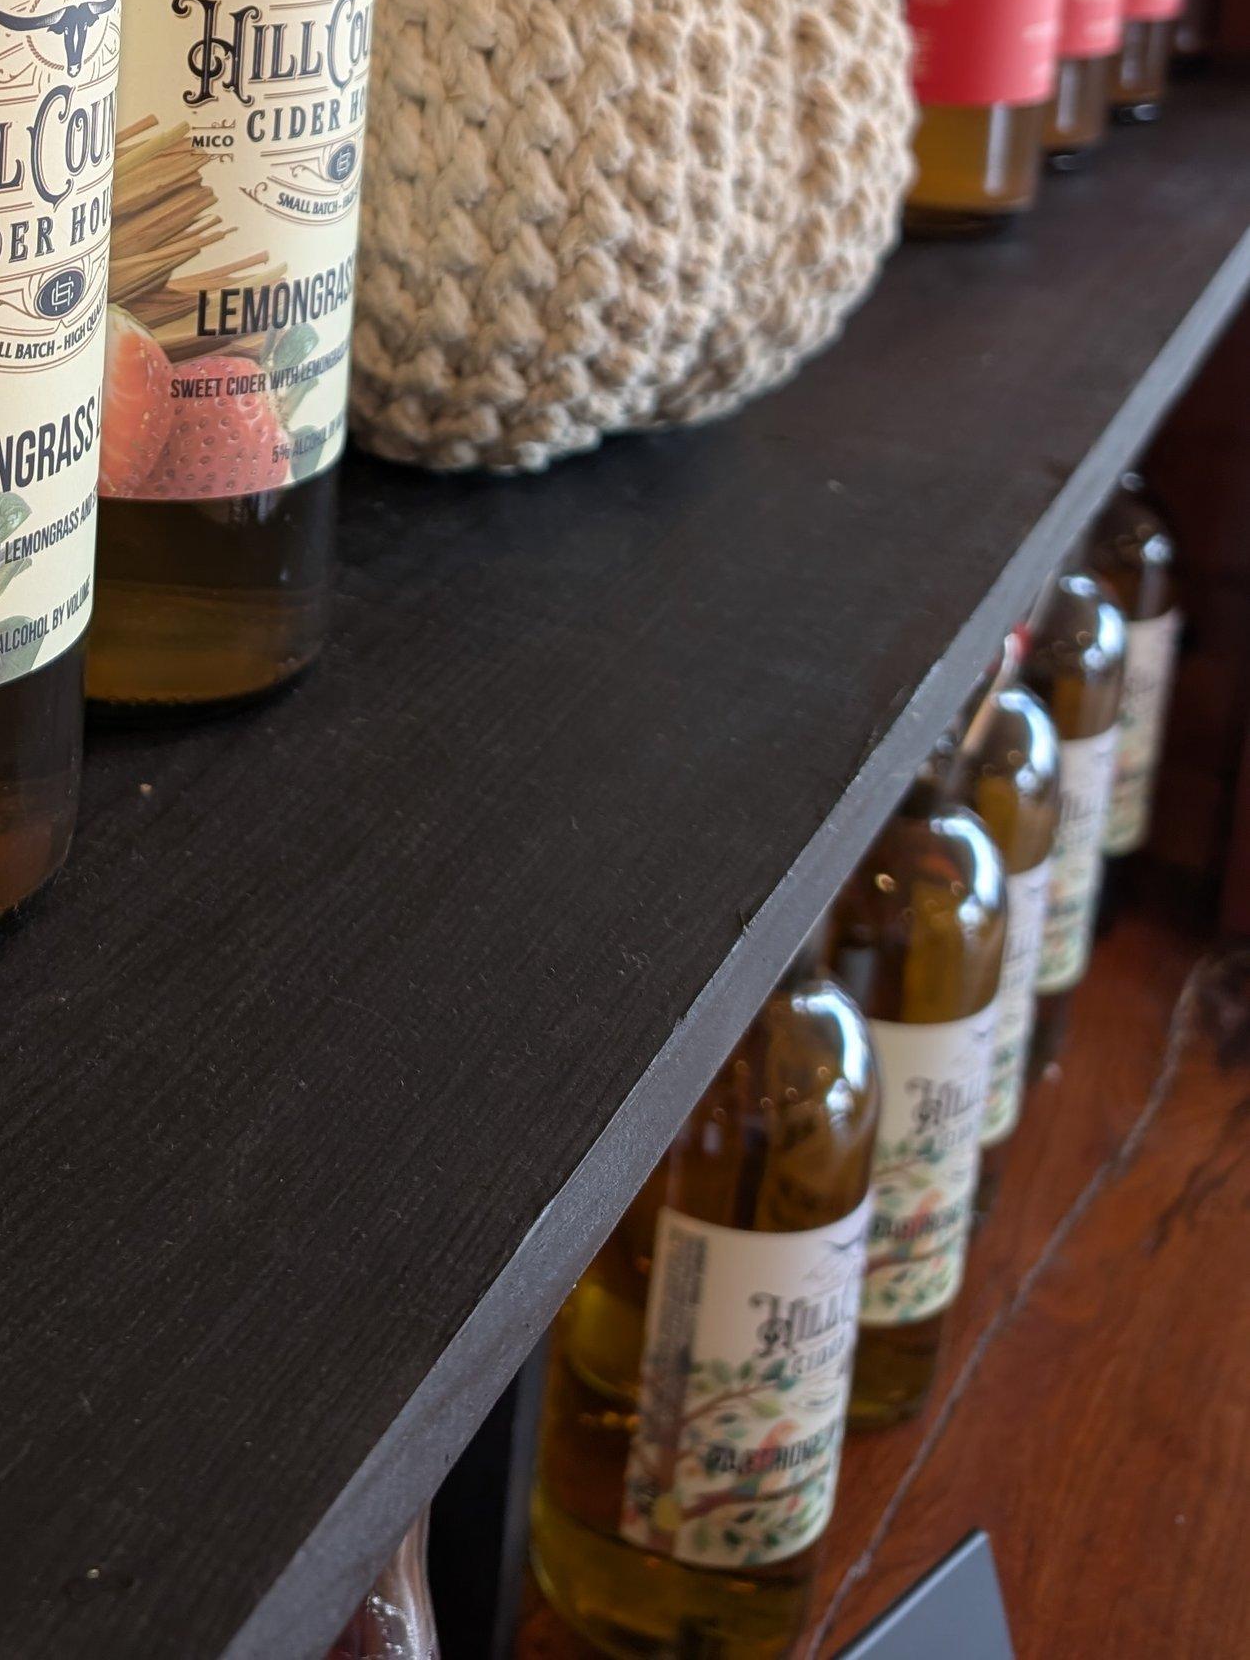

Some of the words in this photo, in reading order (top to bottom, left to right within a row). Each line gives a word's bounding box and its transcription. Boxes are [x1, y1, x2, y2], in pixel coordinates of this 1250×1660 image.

[191, 135, 235, 148] MICO
[246, 98, 341, 142] CIDER
[26, 85, 116, 212] COUN
[71, 184, 112, 245] HOU
[277, 192, 311, 215] SMALL
[312, 199, 338, 215] BATCH
[15, 340, 54, 359] BATCH
[64, 324, 86, 350] HIGH
[171, 378, 223, 399] SWEET
[226, 373, 266, 396] CIDER
[270, 366, 298, 389] WITH
[5, 509, 79, 563] LEMONGRASS
[52, 606, 64, 630] BY
[66, 574, 90, 618] VOLUME
